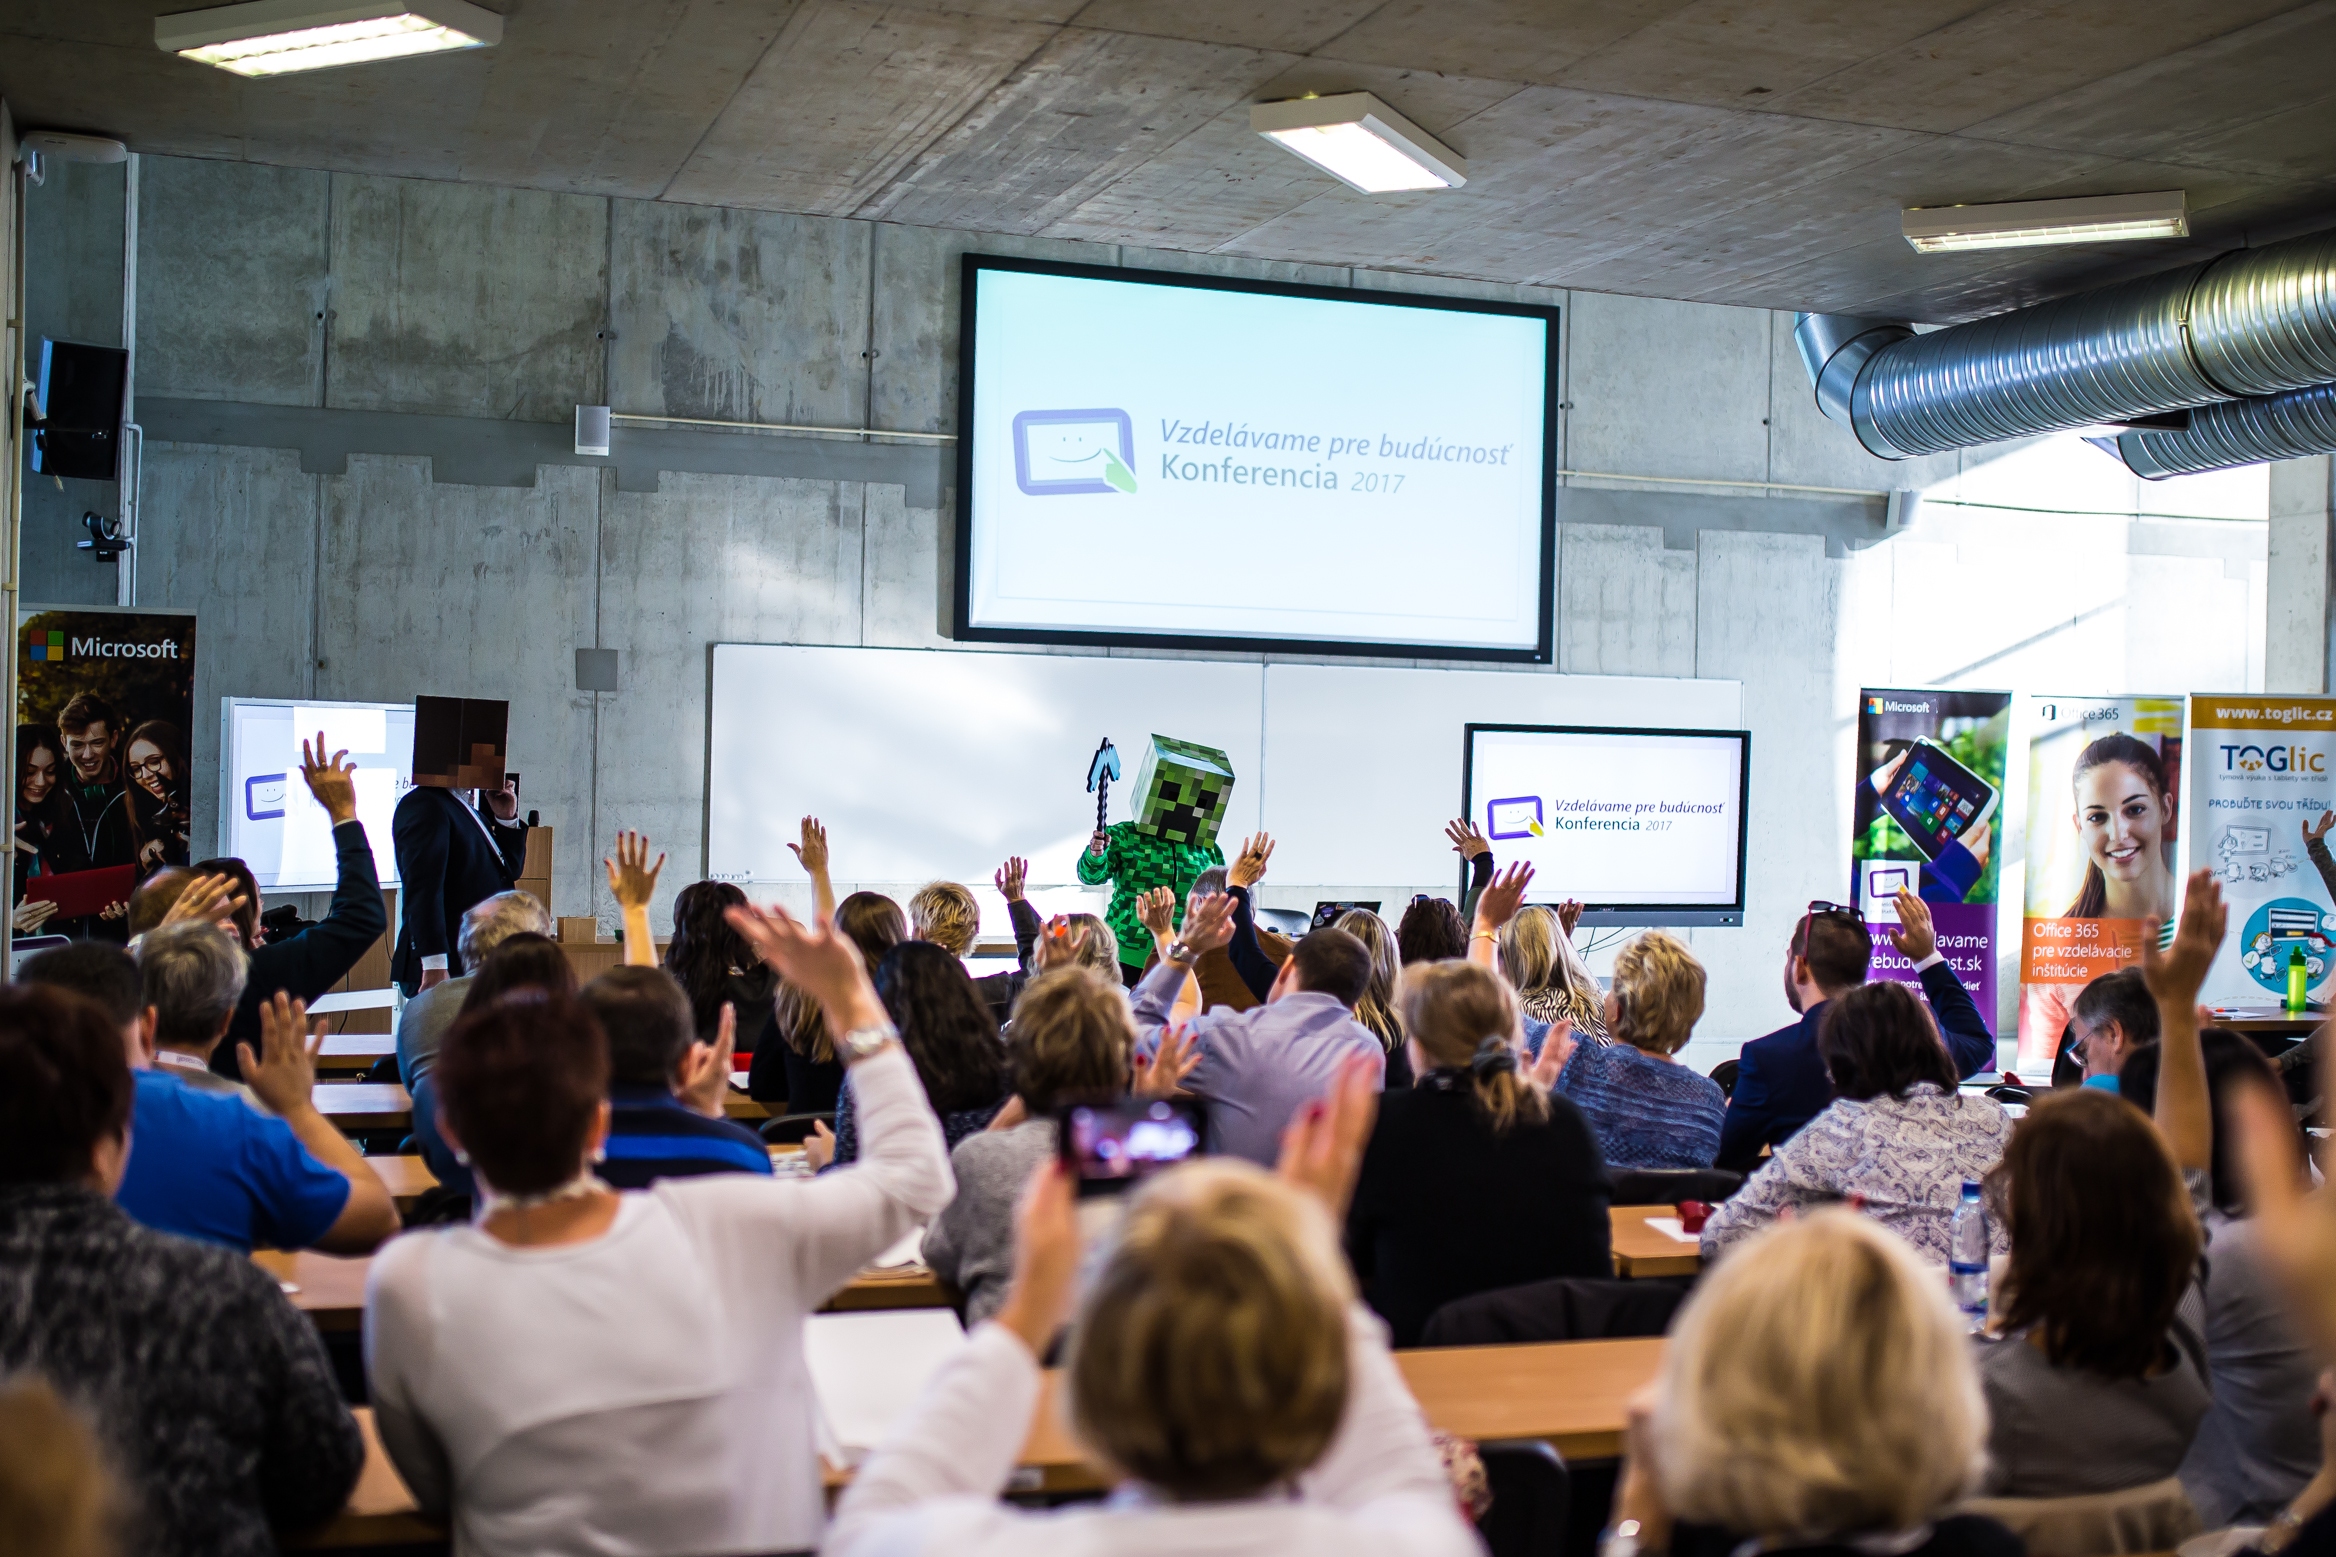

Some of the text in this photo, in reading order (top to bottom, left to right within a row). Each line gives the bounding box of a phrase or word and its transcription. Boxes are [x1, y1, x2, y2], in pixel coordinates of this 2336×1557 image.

[1161, 418, 1514, 466] Vzdelávame pre budúcnosť
[1162, 453, 1406, 494] Konferencia 2017
[71, 636, 178, 659] Microsoft
[1885, 701, 1930, 714] Microsoft
[2097, 707, 2119, 721] 365
[2216, 706, 2334, 724] www.toglic.cz
[1555, 799, 1726, 816] Vzdelávame pre budúcnosť
[2208, 796, 2331, 811] PROBUĎTE SVOU TŘÍDU!
[1555, 816, 1673, 831] Konferencia 2017
[2033, 922, 2099, 938] Office 365
[2032, 943, 2133, 960] pre vzdelávacie
[2032, 962, 2089, 978] inštitúcie
